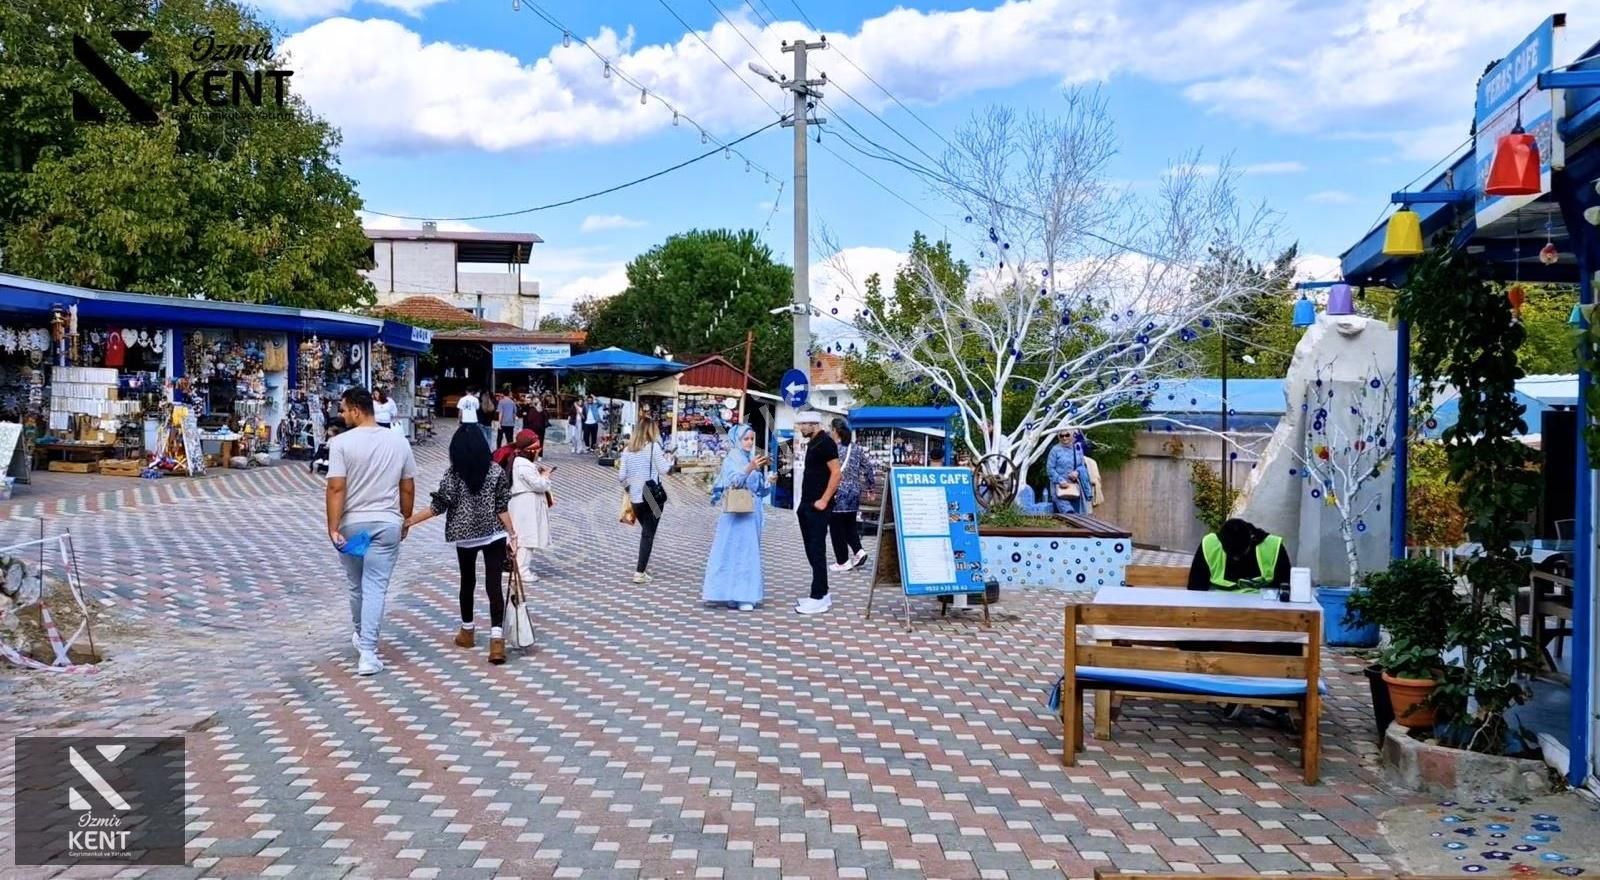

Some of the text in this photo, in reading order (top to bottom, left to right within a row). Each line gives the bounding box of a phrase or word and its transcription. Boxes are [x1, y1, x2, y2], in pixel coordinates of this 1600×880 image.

[1485, 38, 1540, 107] TERAS CAFE
[896, 473, 969, 485] TERAS CAFE
